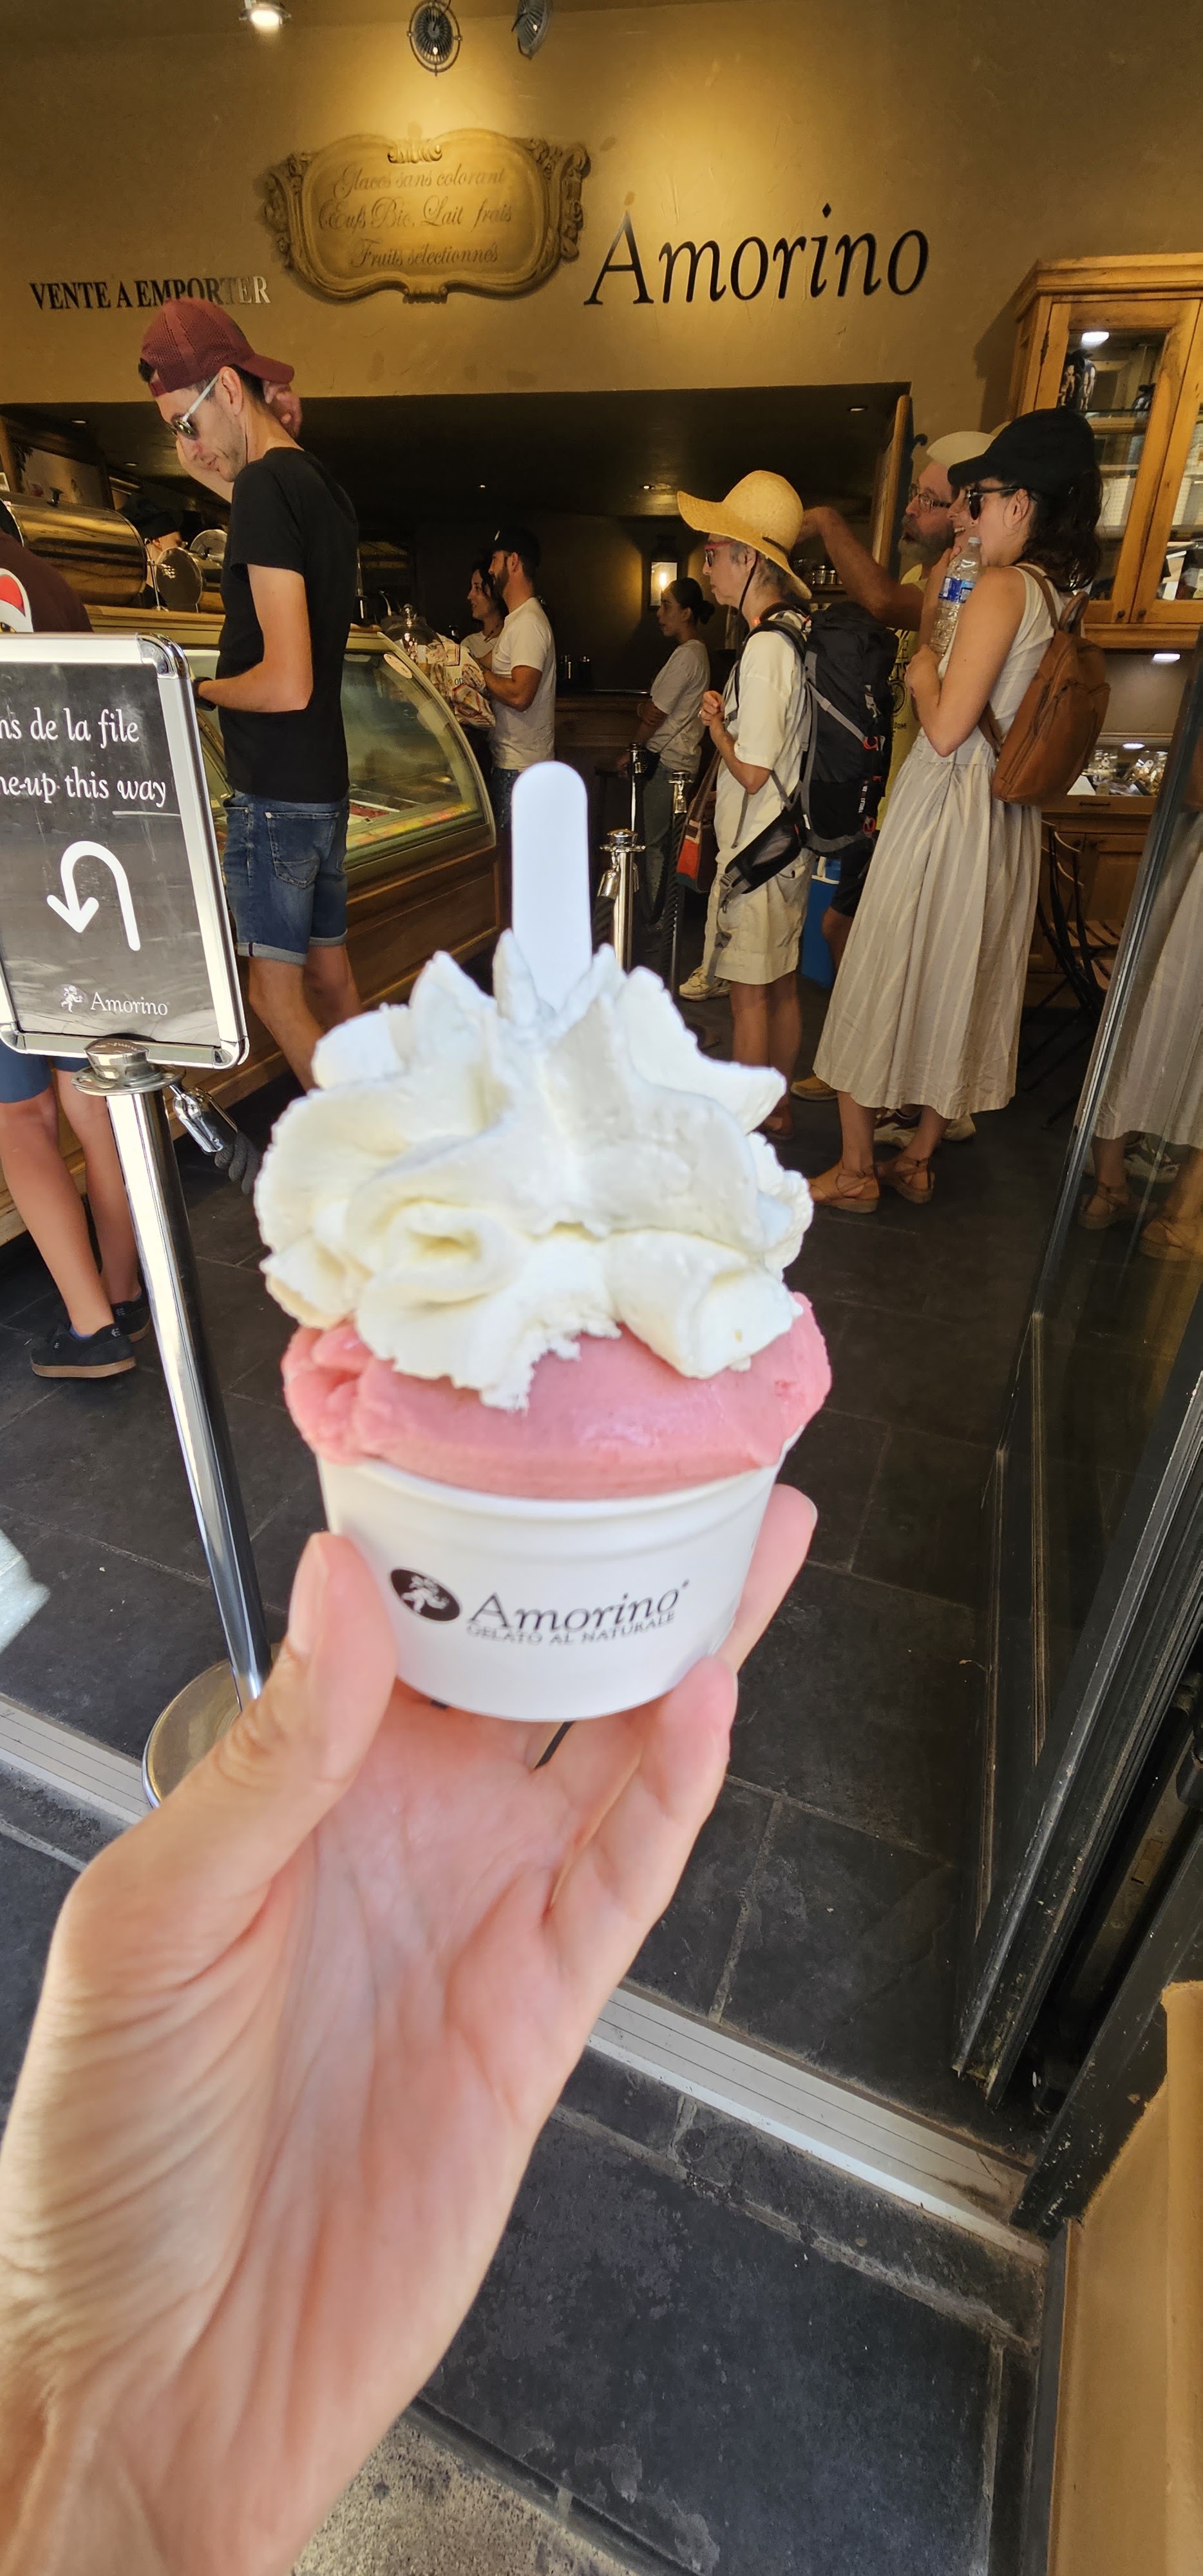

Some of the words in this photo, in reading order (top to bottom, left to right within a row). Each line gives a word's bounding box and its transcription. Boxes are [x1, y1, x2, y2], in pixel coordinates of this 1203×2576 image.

[333, 164, 391, 199] Glaces
[395, 169, 432, 188] sans
[436, 162, 505, 187] colorant
[421, 195, 464, 227] Lait
[471, 198, 513, 232] frais
[350, 237, 403, 269] Fruits
[583, 202, 929, 305] Amorino
[29, 281, 111, 310] VENTE
[116, 280, 133, 308] A
[133, 276, 271, 307] EMPORTER
[30, 707, 58, 740] de
[63, 707, 91, 741] la
[98, 708, 139, 749] file
[64, 766, 109, 799] this
[117, 780, 166, 808] way
[90, 991, 168, 1016] Amorino
[466, 1623, 543, 1645] GELATO
[549, 1633, 574, 1645] AL
[582, 1612, 676, 1642] NATURALE
[469, 1588, 680, 1632] Amorino
